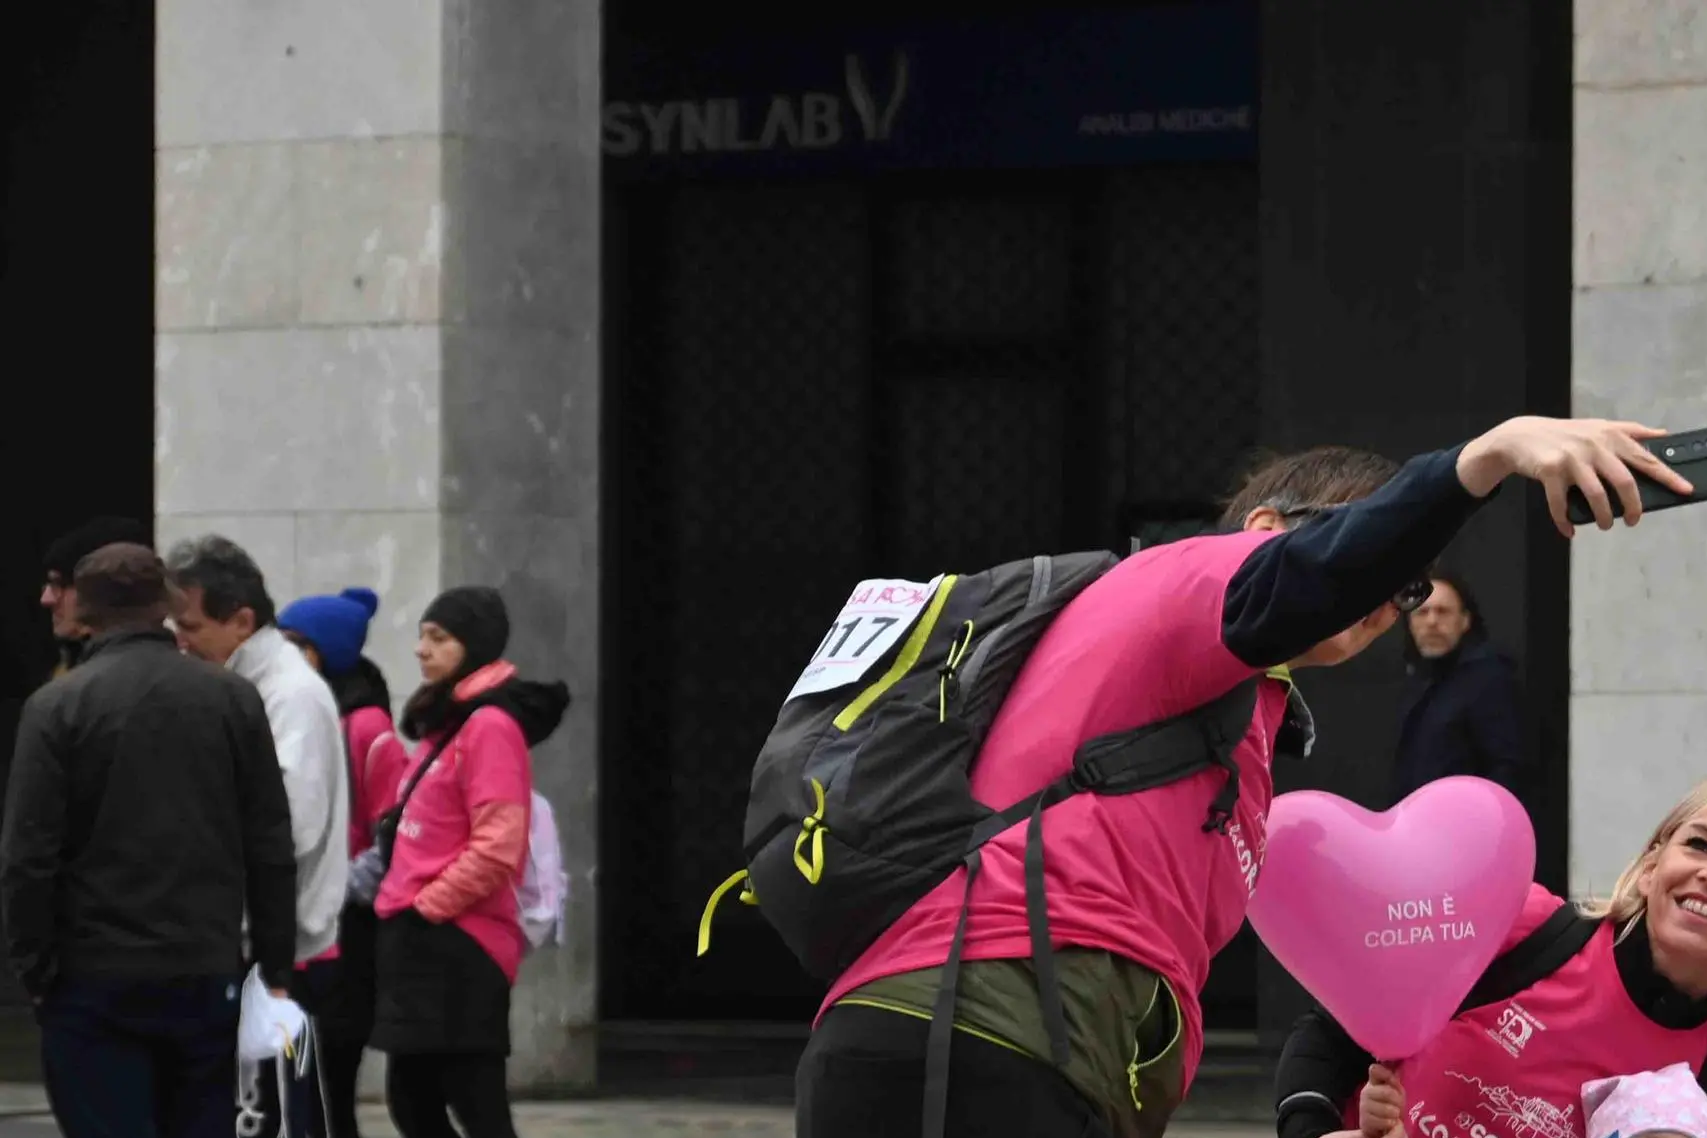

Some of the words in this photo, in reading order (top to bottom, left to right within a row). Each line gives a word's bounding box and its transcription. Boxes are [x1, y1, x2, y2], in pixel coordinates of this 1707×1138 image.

[602, 92, 841, 156] SYNLAB
[1387, 897, 1433, 921] NON
[1442, 892, 1456, 915] È
[1364, 925, 1434, 948] COLPA
[1439, 920, 1475, 941] TUA
